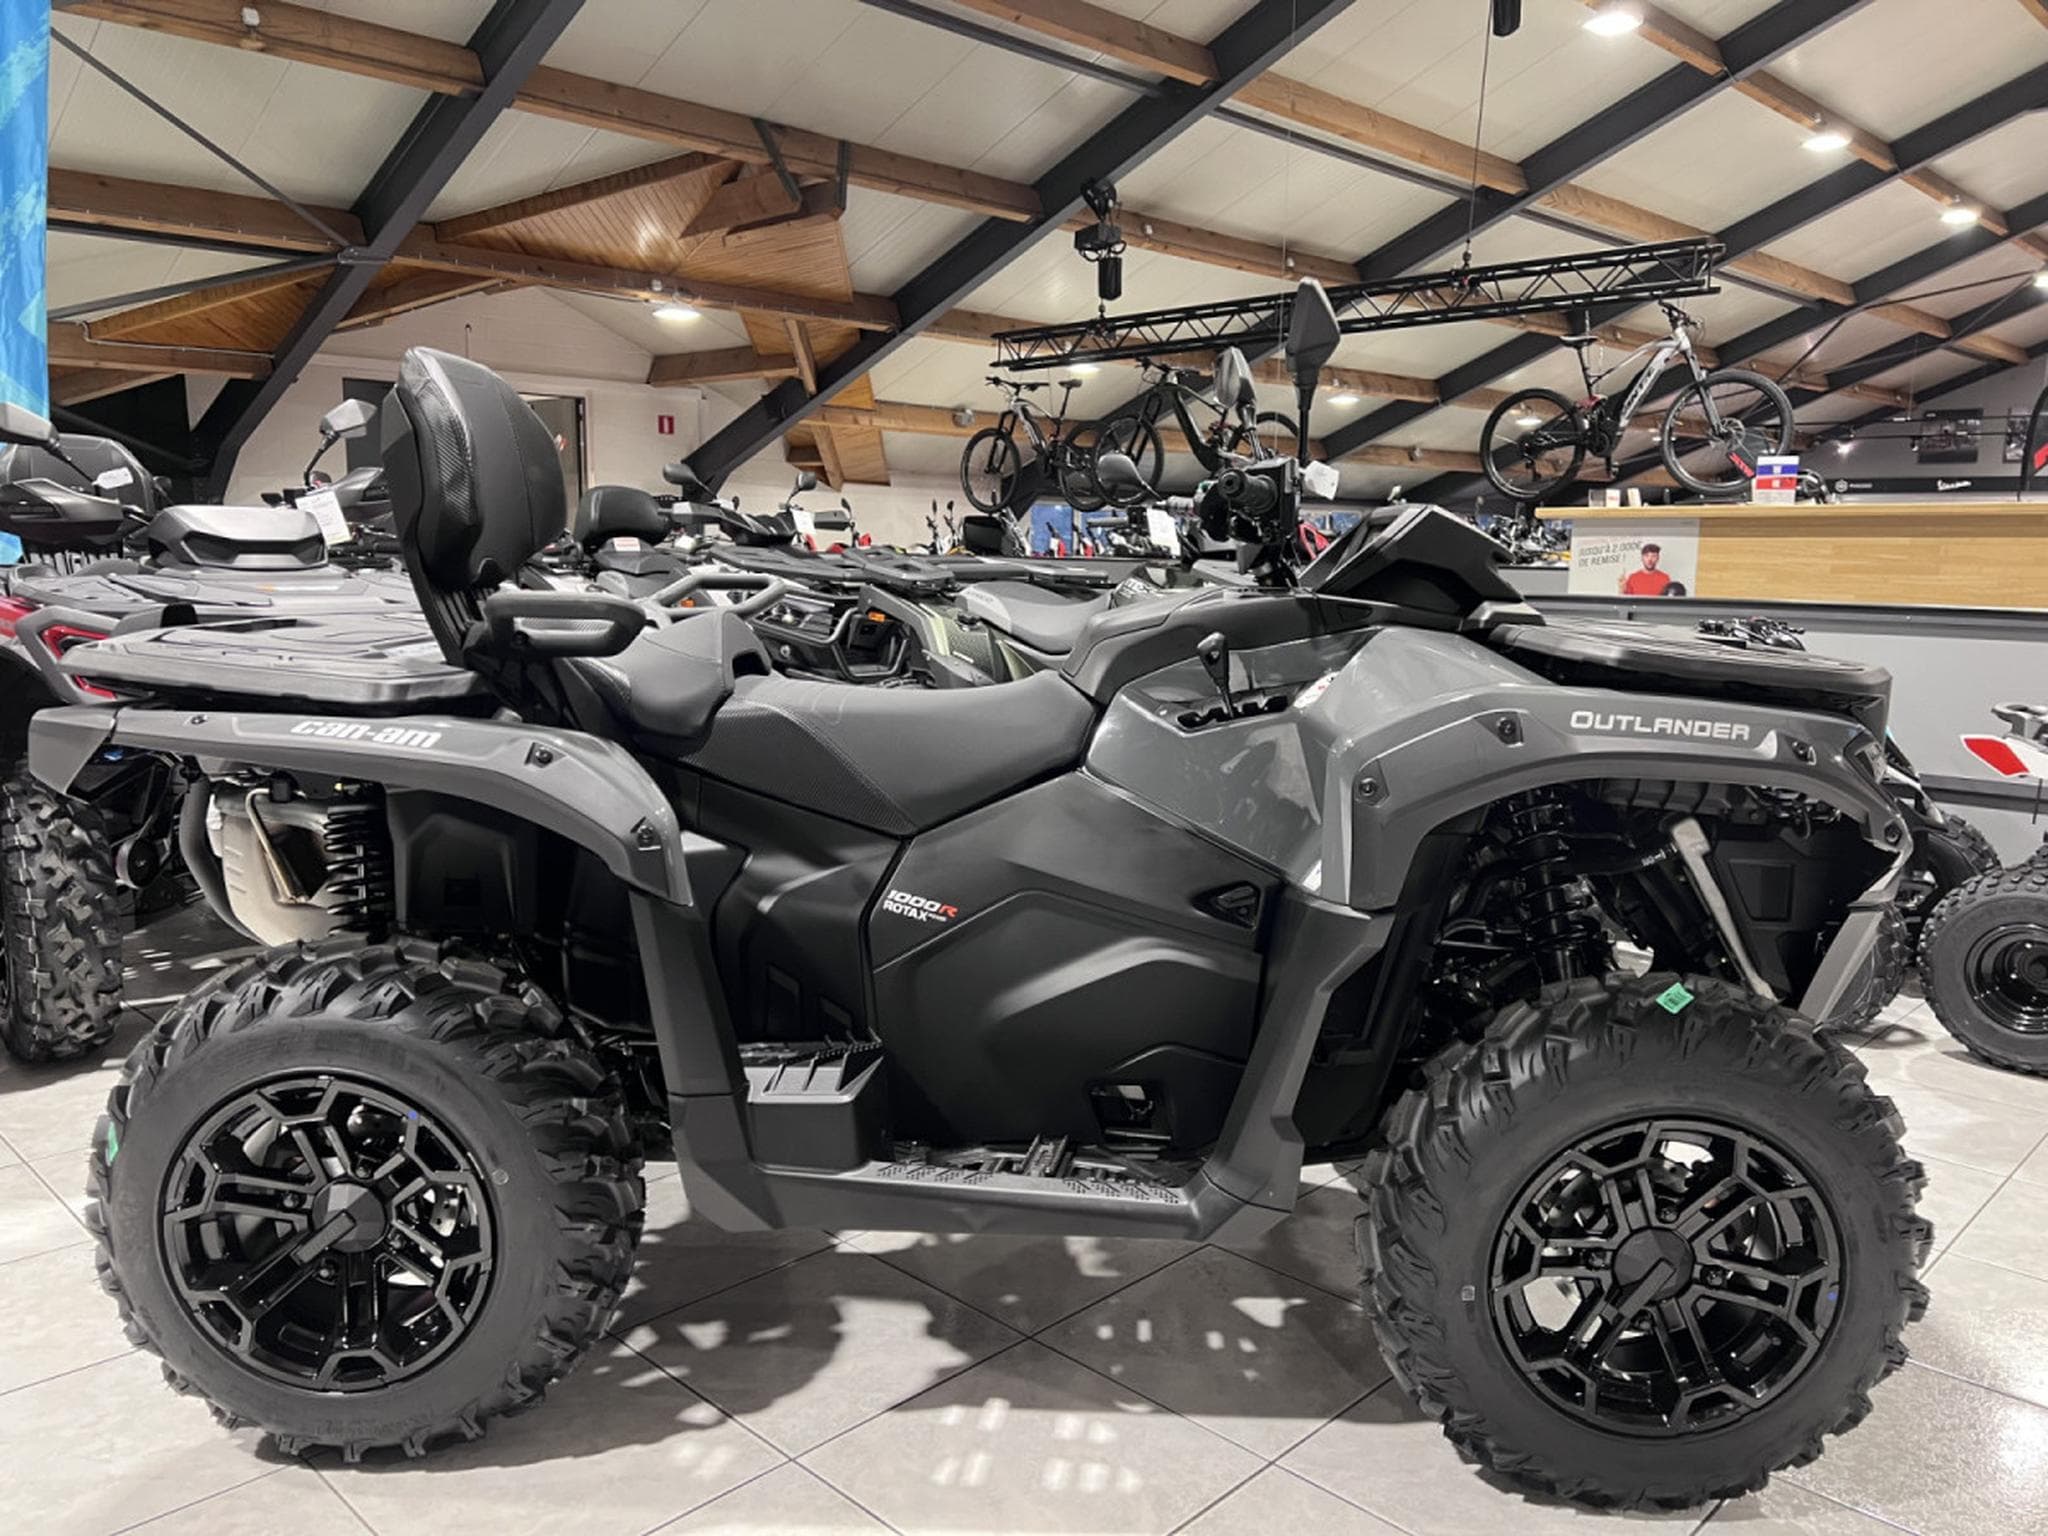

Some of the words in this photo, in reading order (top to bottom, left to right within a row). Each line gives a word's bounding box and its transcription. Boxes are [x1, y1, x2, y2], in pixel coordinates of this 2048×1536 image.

[290, 720, 442, 748] can-am
[1570, 710, 1751, 741] OUTLANDER
[883, 900, 929, 923] ROTAX
[887, 890, 959, 917] 1000R
